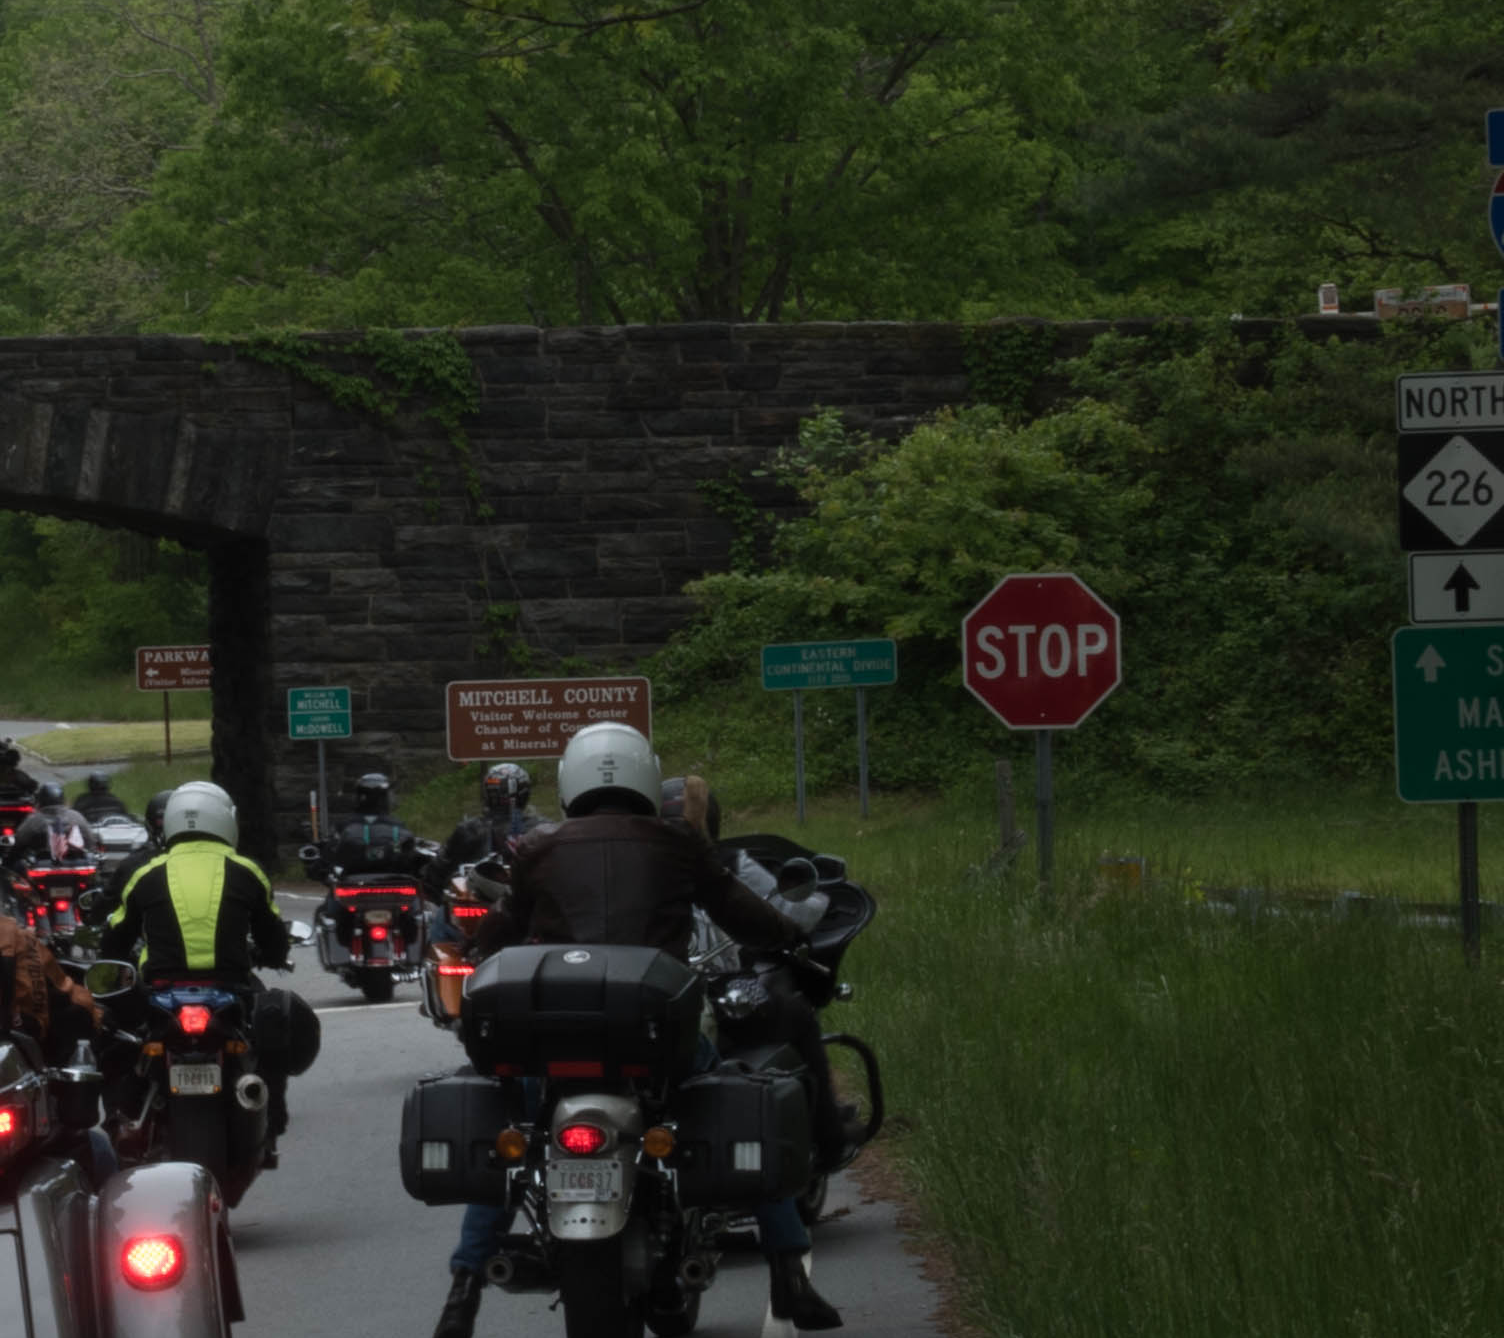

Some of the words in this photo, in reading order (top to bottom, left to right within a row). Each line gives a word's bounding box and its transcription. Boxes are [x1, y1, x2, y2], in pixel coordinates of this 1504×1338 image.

[1426, 469, 1494, 506] 226
[144, 649, 209, 663] PARKWA
[800, 645, 857, 660] EASTERN
[975, 622, 1109, 680] STOP
[766, 661, 846, 676] CONTINENTAL
[852, 657, 892, 672] DIVIDE
[458, 689, 553, 707] MITCHELL
[563, 685, 639, 703] COUNTY
[470, 709, 514, 722] Visitor
[522, 708, 580, 721] Welcome
[587, 708, 629, 720] Center
[474, 723, 530, 736] Chamber
[538, 723, 552, 734] of
[503, 738, 560, 750] Minerals
